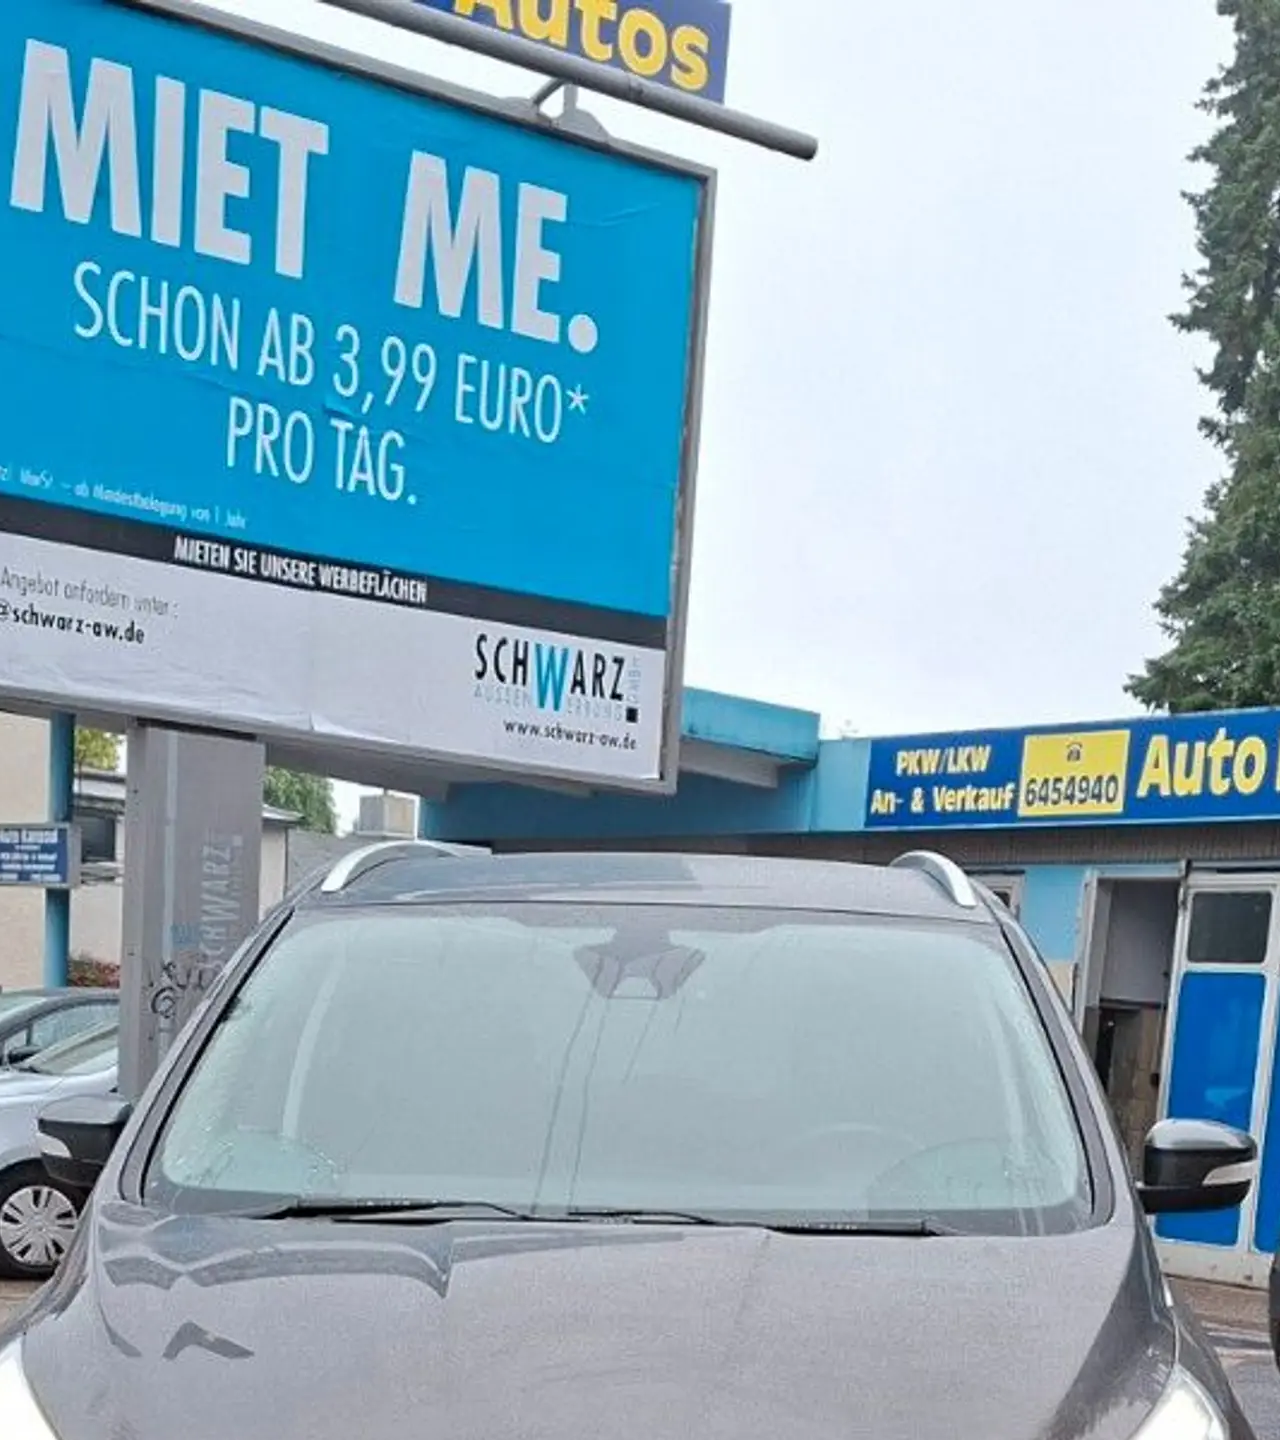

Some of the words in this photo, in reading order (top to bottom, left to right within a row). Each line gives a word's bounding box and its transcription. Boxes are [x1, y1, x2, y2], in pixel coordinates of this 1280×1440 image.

[9, 37, 328, 279] MIET
[392, 150, 598, 353] ME.
[73, 260, 241, 372] SCHON
[258, 306, 316, 388] AB
[332, 325, 438, 415] 3,99
[225, 397, 314, 484] PRO
[329, 418, 417, 505] TAG.
[1, 565, 59, 597] Angebot
[175, 534, 229, 568] MIETEN
[234, 549, 257, 575] SIE
[260, 553, 316, 587] UNSERE
[319, 565, 427, 603] WERBEFLÄCHEN
[896, 745, 991, 777] PKW/LKW
[1025, 774, 1119, 807] 6454940
[1137, 728, 1266, 797] Auto
[910, 787, 924, 813] &
[932, 782, 1015, 811] Verkauf
